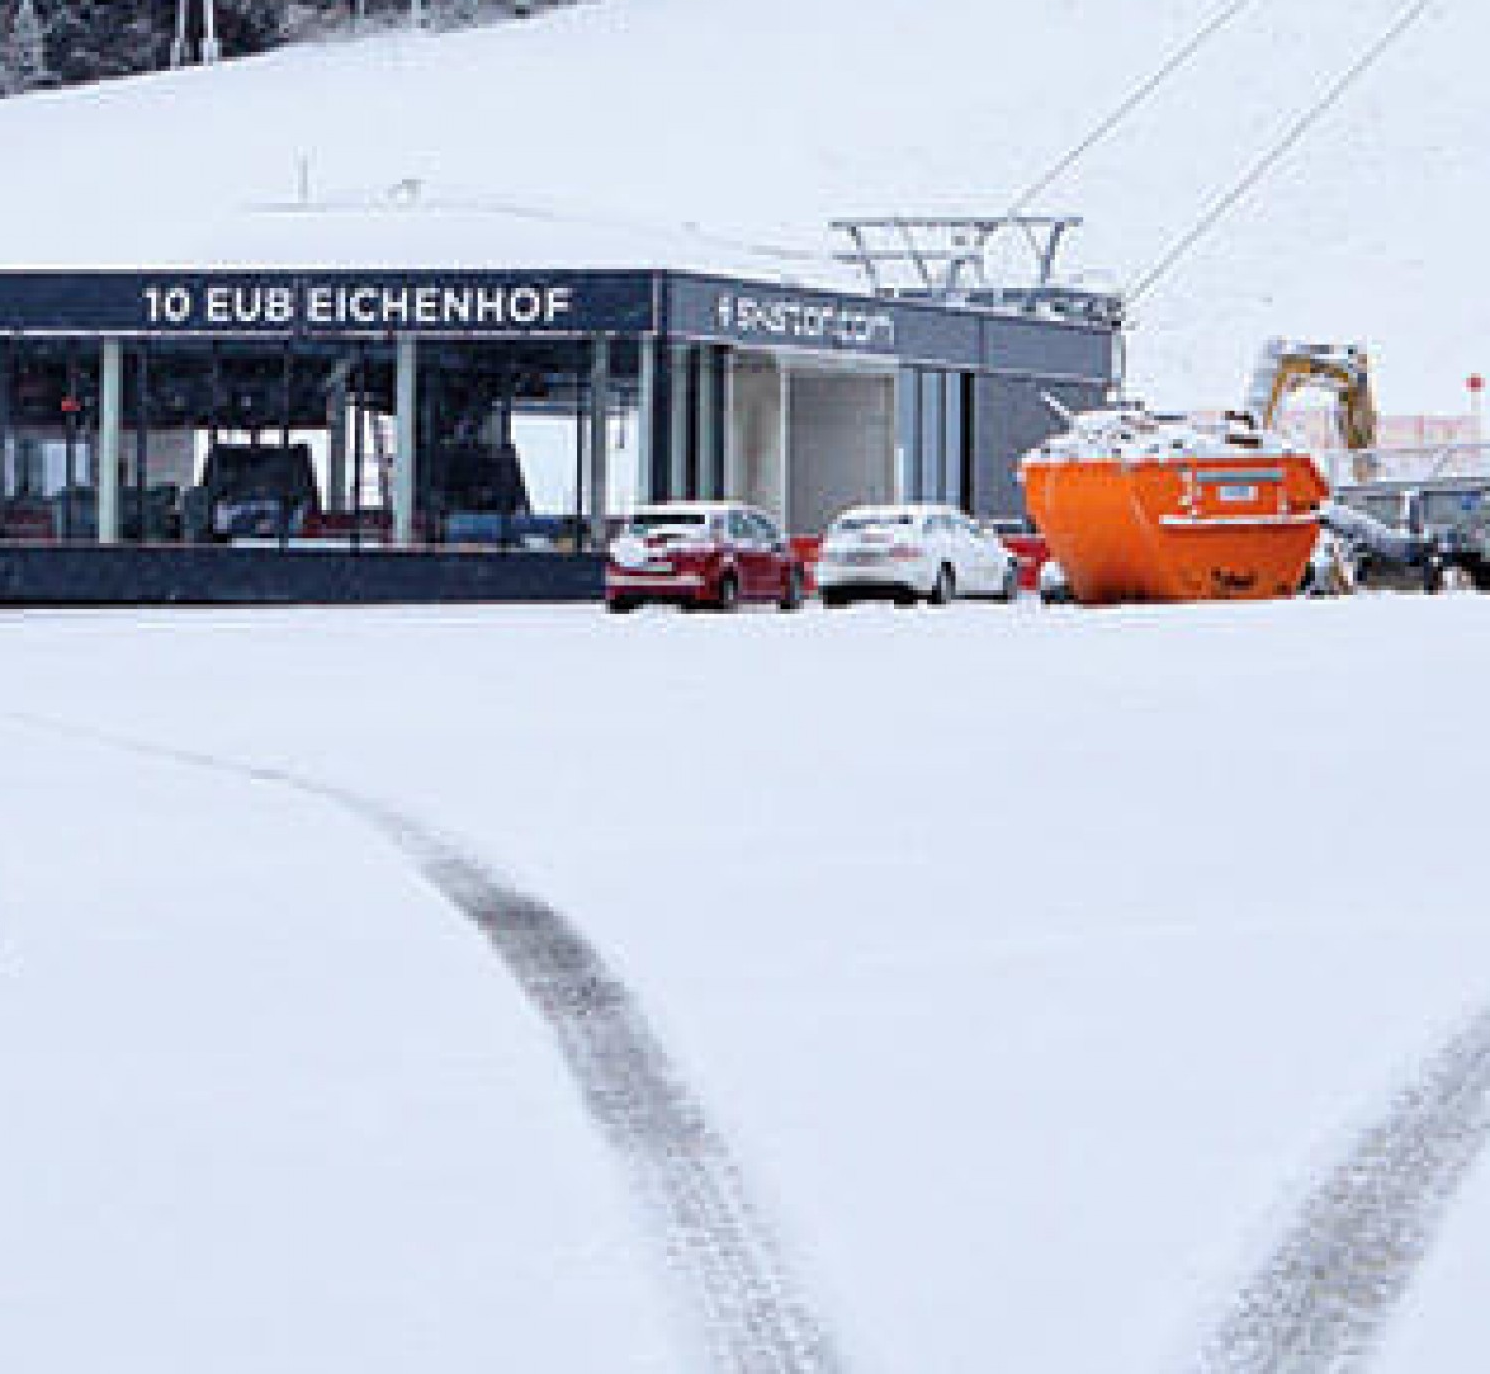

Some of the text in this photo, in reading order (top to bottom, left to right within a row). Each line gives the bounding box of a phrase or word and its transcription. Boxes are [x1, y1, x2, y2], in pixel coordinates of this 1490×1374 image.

[142, 286, 575, 322] 10 EUB EICHENHOF
